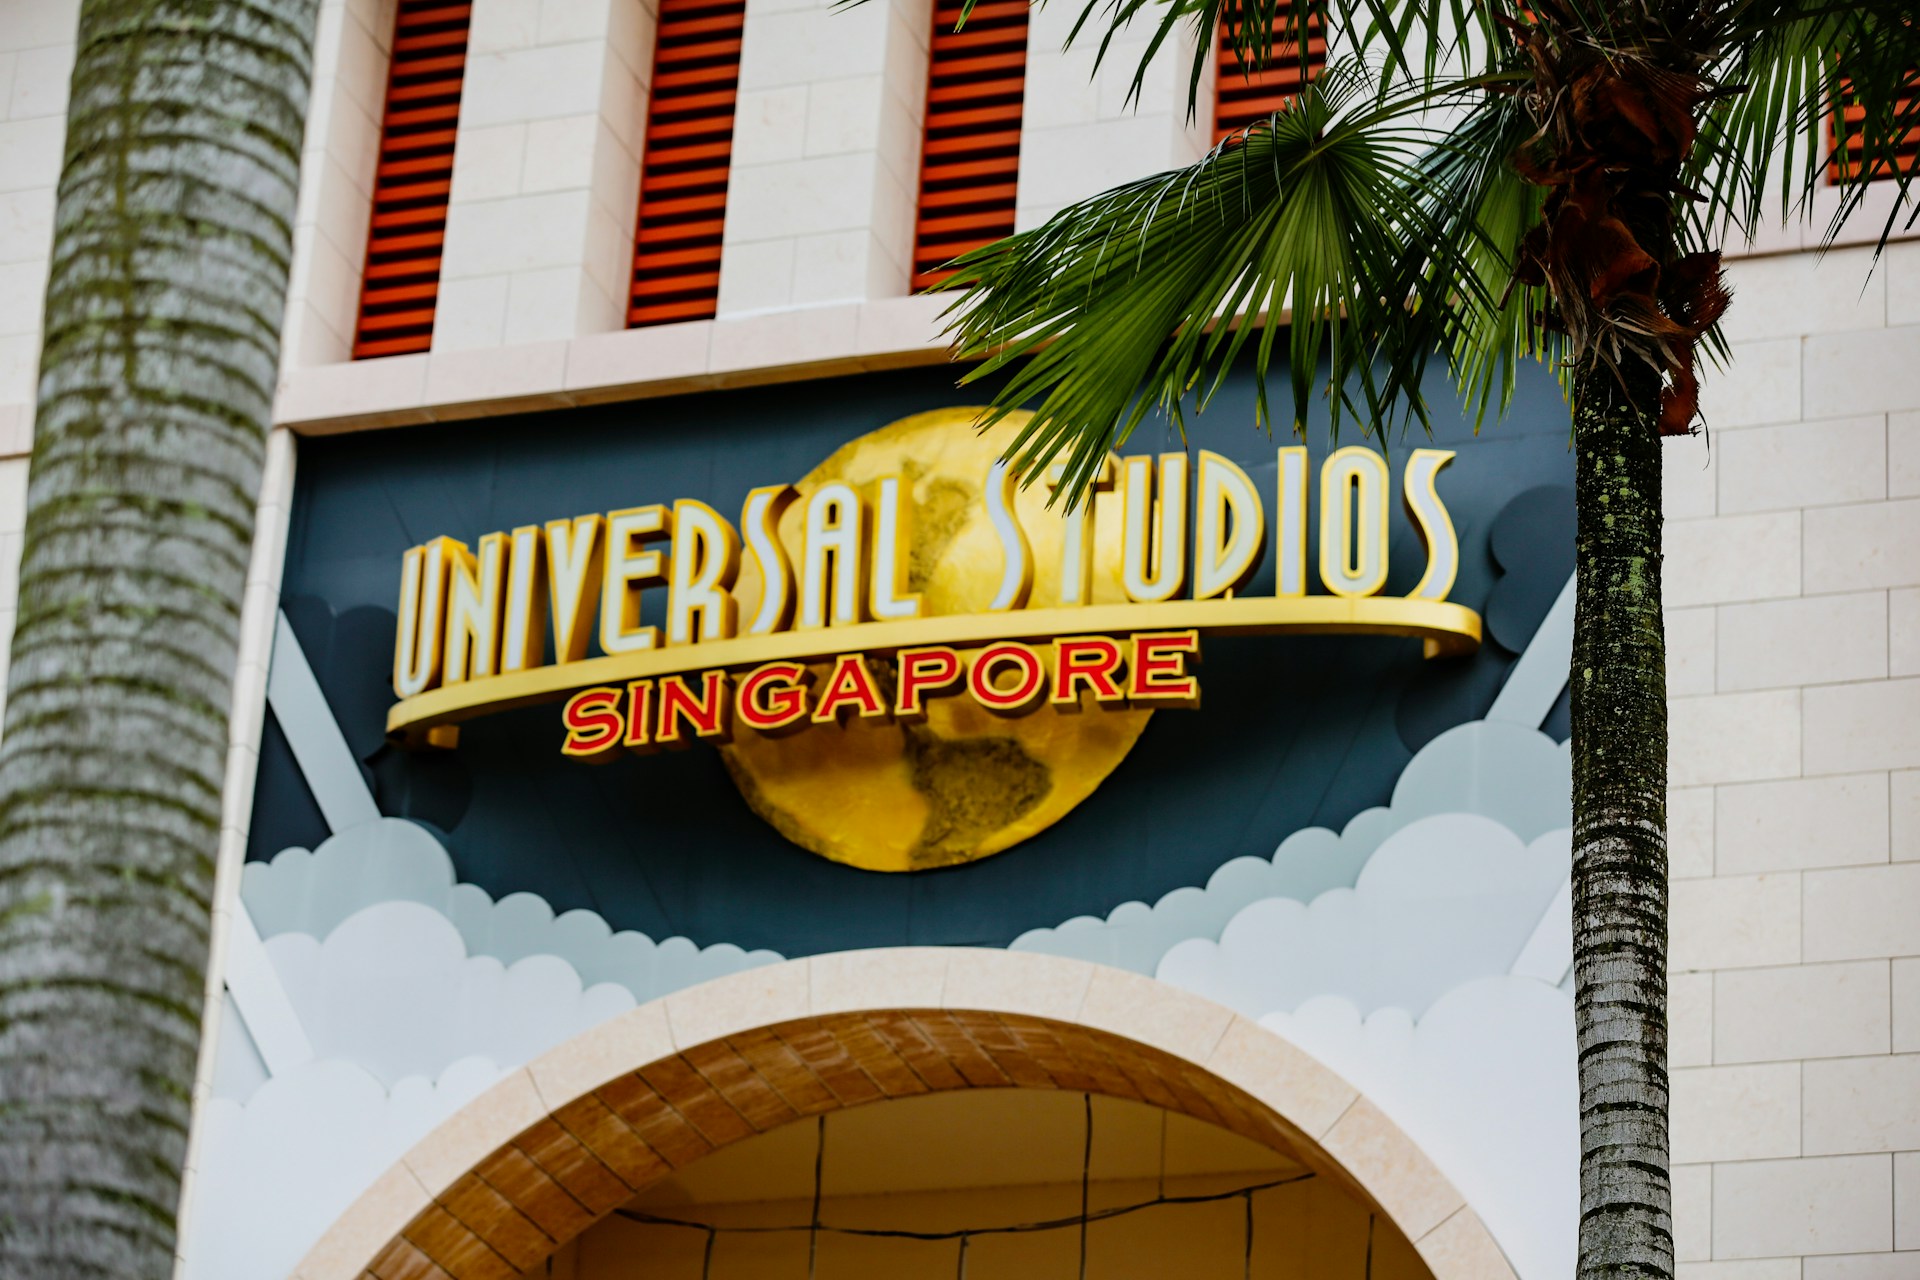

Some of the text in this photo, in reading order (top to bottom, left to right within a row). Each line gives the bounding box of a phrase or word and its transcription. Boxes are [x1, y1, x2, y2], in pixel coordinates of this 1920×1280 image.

[393, 446, 1459, 698] UNIVERSAL STUDIOS
[561, 629, 1199, 756] SINGAPORE
